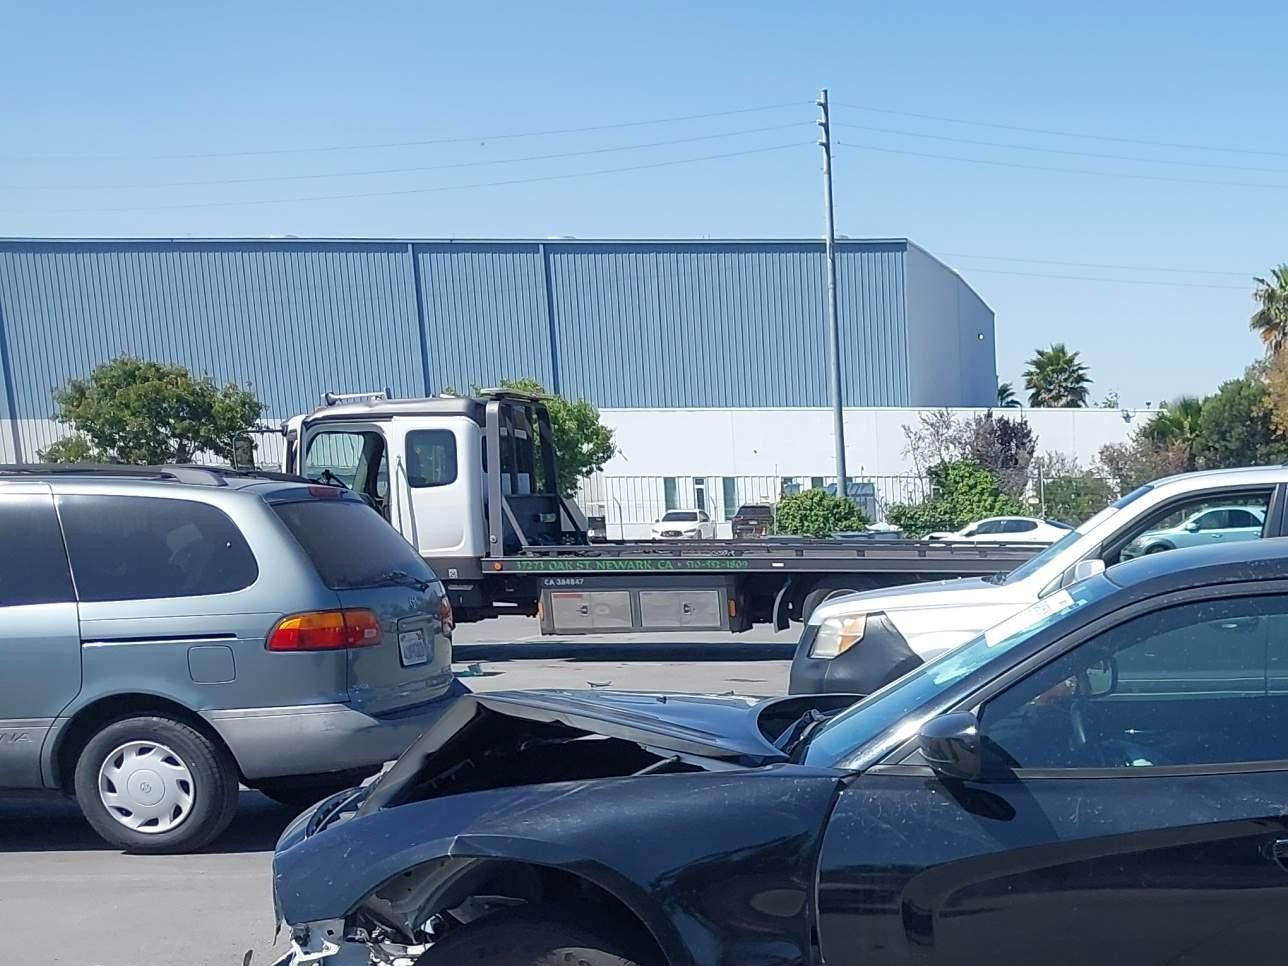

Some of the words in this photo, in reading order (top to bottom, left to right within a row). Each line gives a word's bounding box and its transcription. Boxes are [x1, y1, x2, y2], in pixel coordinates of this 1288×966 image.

[549, 560, 573, 570] OAK
[595, 560, 652, 570] NEWARK
[657, 560, 674, 570] CA
